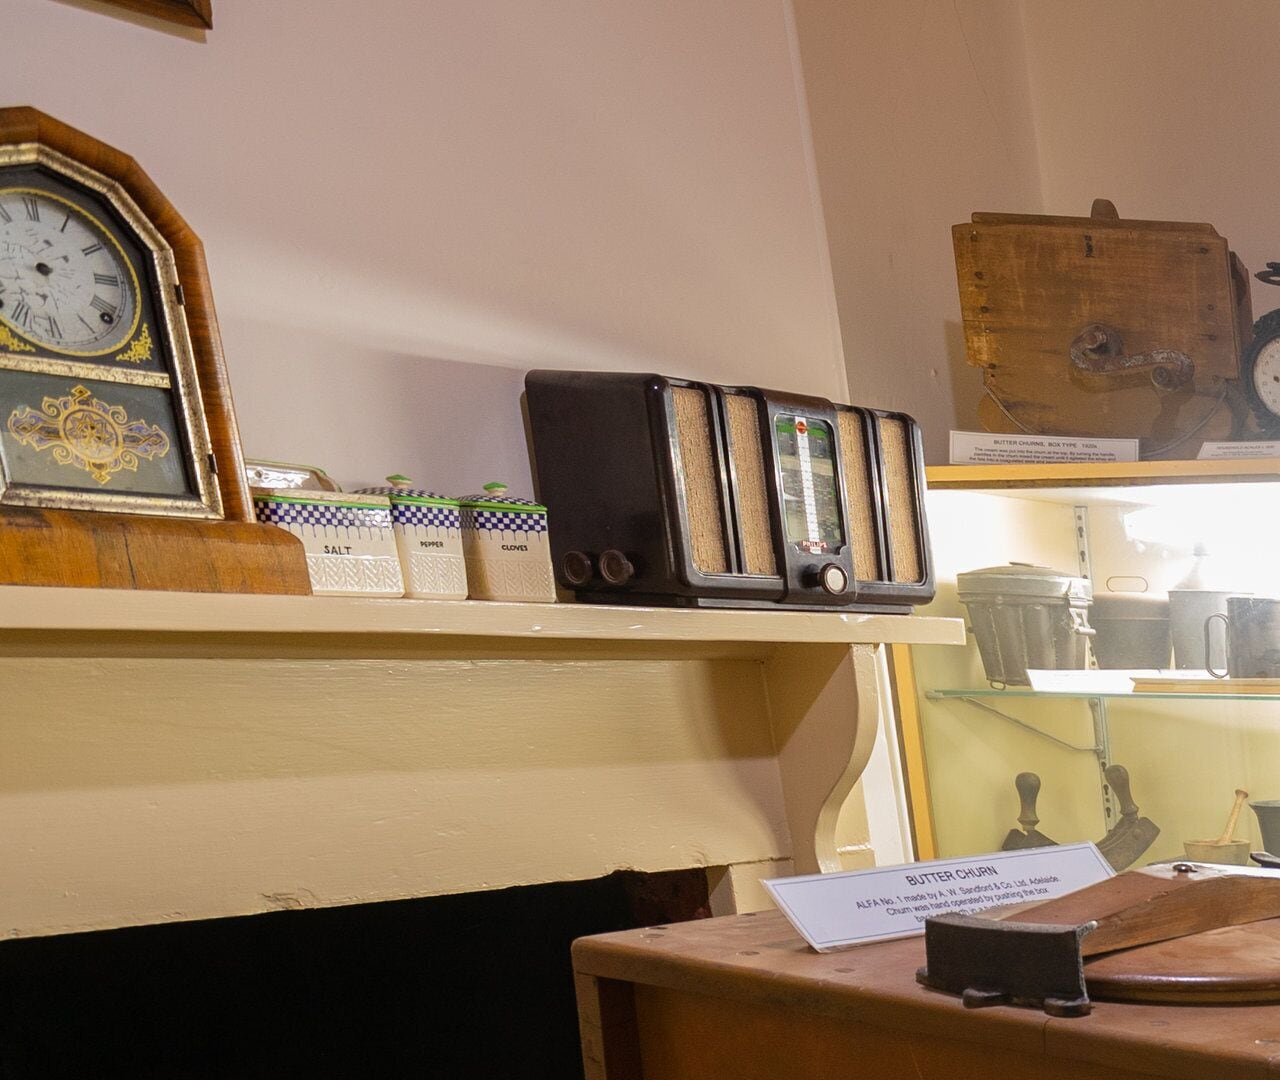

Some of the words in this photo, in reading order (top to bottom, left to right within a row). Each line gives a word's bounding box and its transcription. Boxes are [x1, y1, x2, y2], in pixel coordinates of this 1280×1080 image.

[324, 545, 352, 556] SALT
[420, 541, 444, 549] PEPPER
[501, 544, 528, 552] CLOVES
[905, 870, 955, 886] BUTTER
[955, 866, 999, 880] CHURN
[856, 899, 880, 910] ALFA
[903, 893, 927, 903] made
[926, 891, 938, 900] by
[959, 883, 993, 896] Sandford
[886, 907, 913, 916] Churn
[913, 904, 930, 913] was
[930, 900, 951, 910] hand
[950, 896, 984, 908] operated
[985, 894, 995, 903] by
[994, 890, 1024, 902] pushing
[1024, 887, 1036, 897] the
